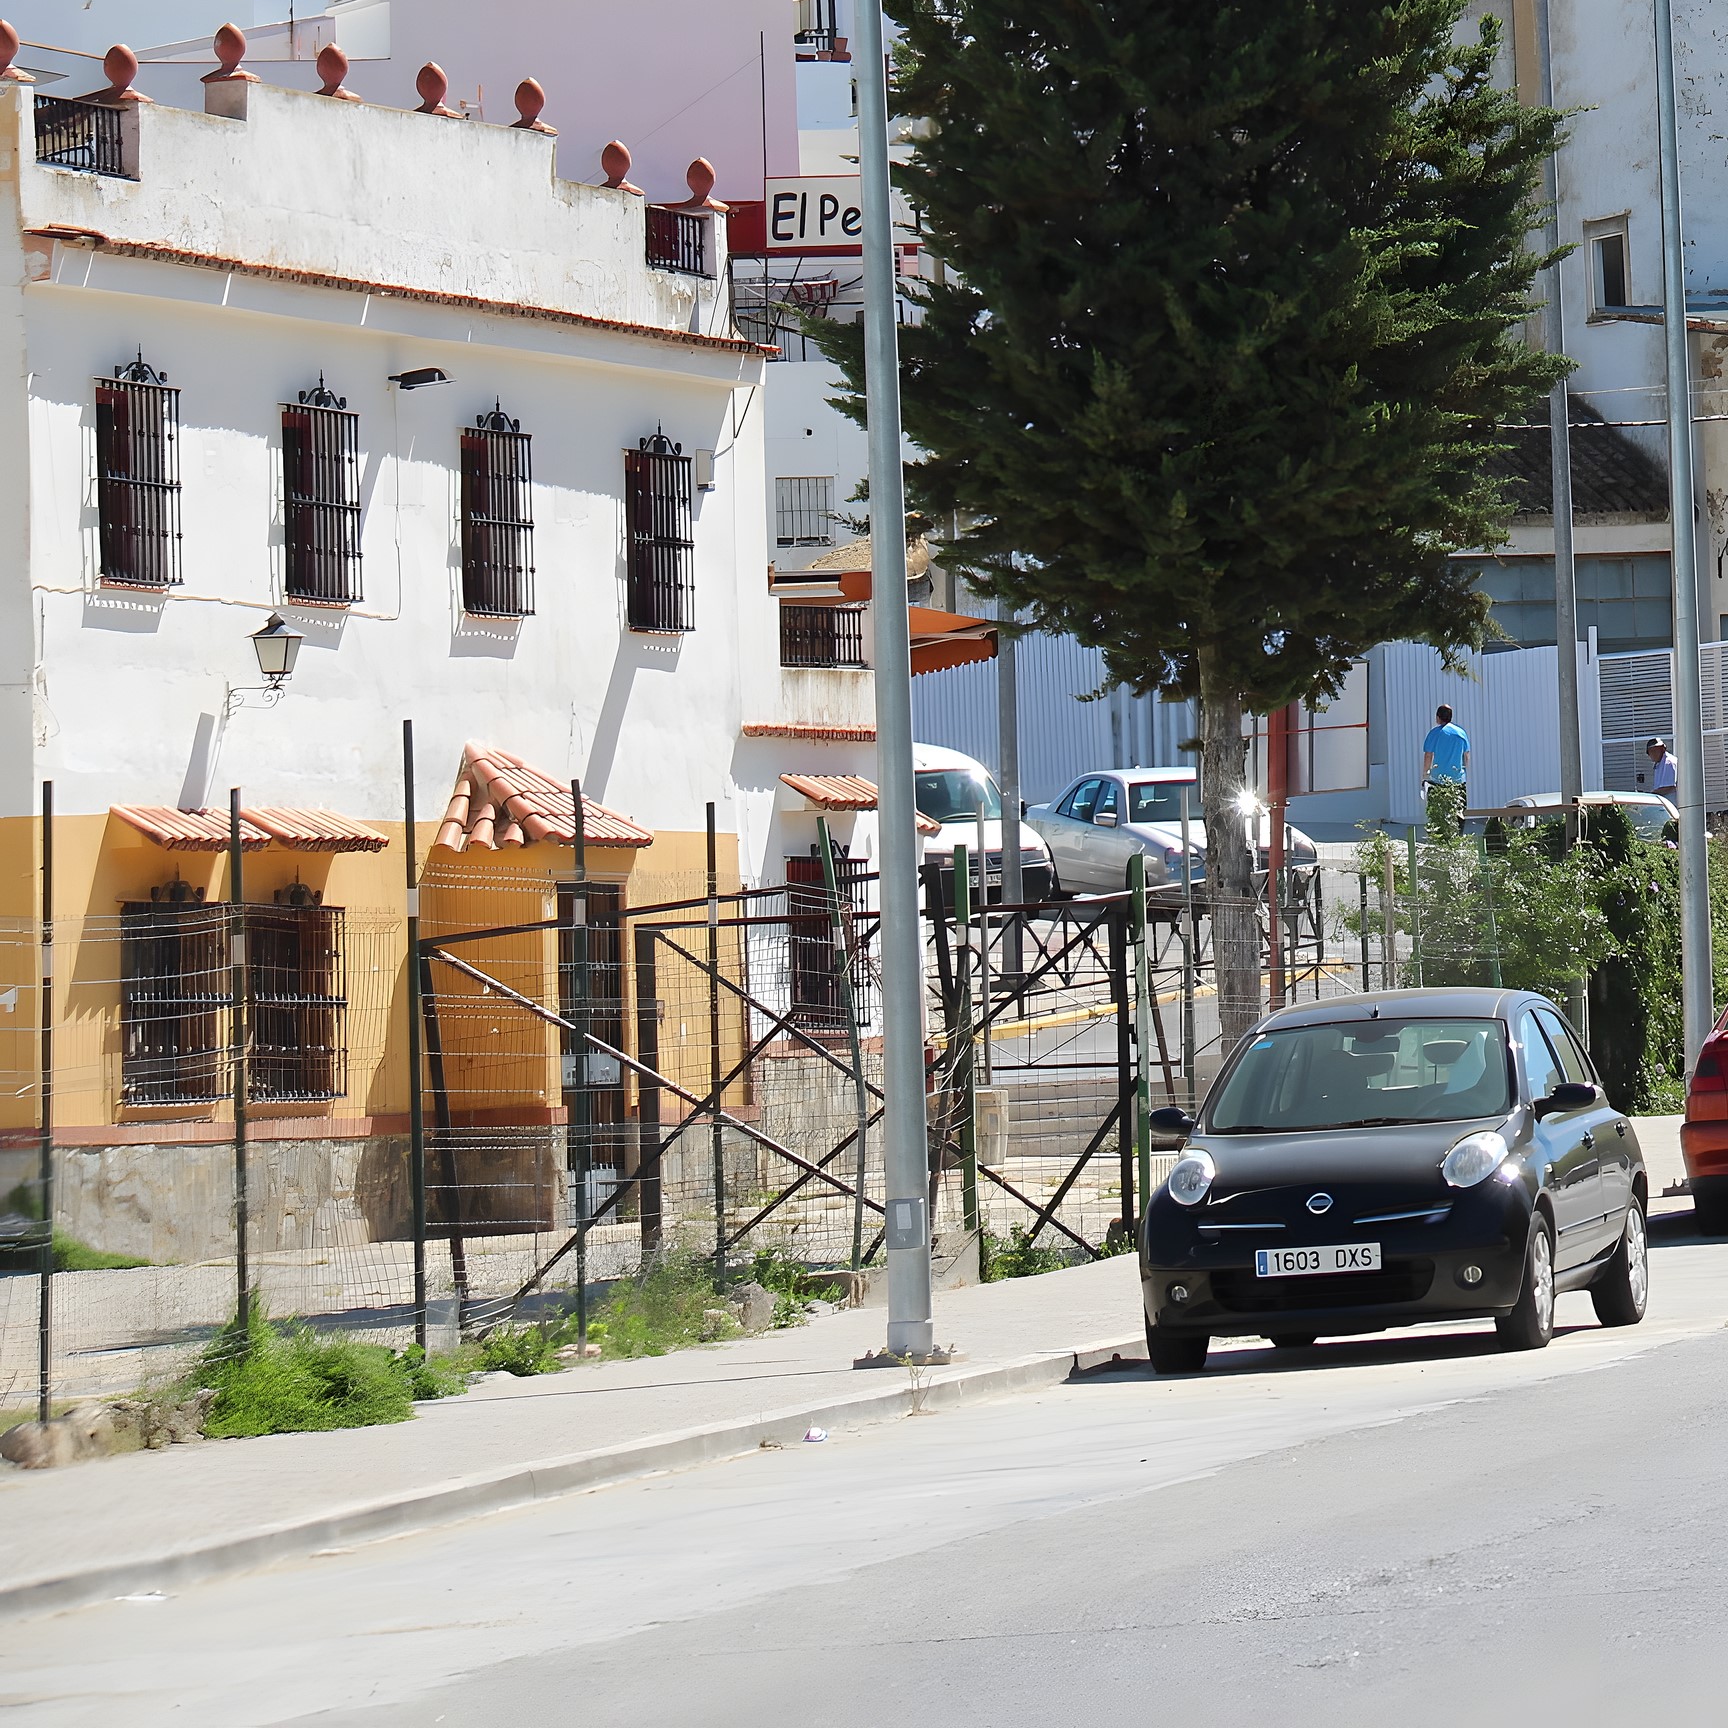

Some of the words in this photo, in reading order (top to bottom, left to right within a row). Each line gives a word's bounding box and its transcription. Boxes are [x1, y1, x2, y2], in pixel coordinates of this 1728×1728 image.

[772, 192, 807, 241] El
[819, 192, 863, 237] Pe
[1274, 1251, 1320, 1272] 1603
[1335, 1248, 1372, 1269] DXS
